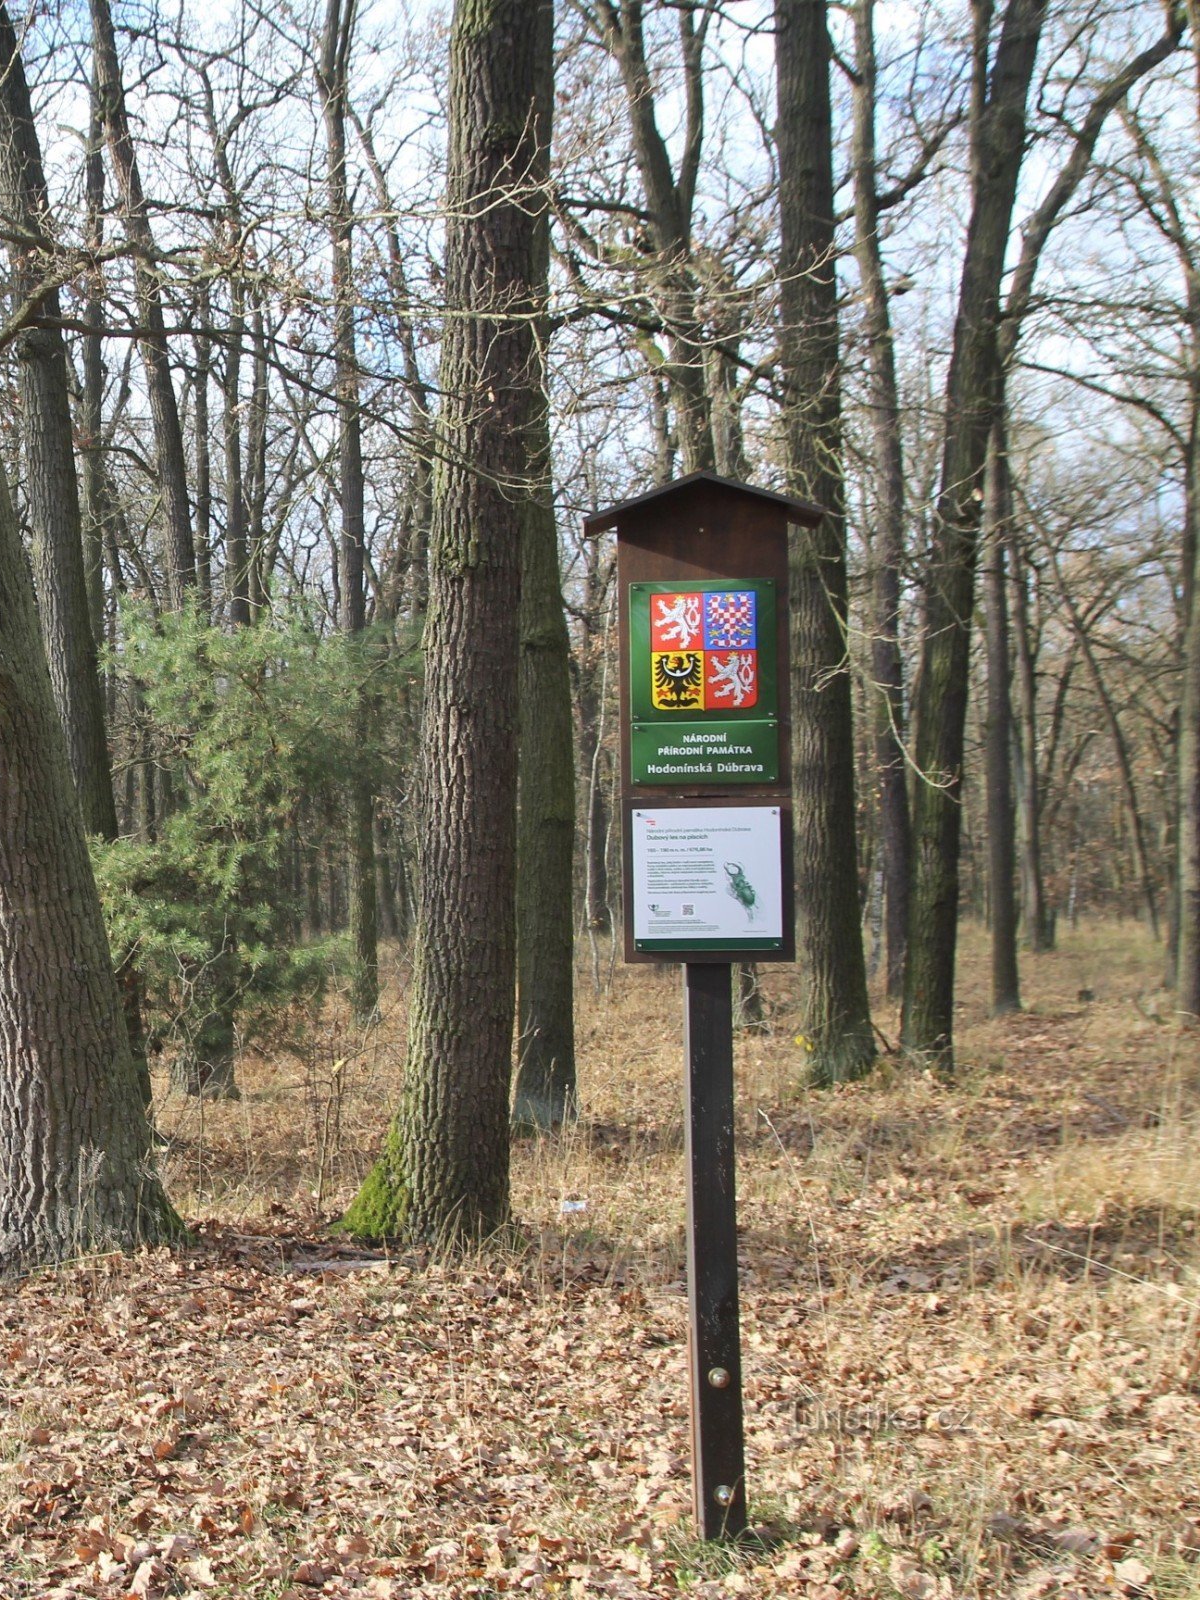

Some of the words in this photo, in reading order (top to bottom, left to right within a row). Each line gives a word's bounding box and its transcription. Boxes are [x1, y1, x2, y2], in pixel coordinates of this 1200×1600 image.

[683, 732, 727, 743] NÁRODNÍ
[658, 745, 703, 756] PŘÍRODNÍ
[706, 744, 753, 755] PAMÁTKA
[647, 763, 713, 774] Hodonínská
[717, 762, 764, 773] Dúbrava
